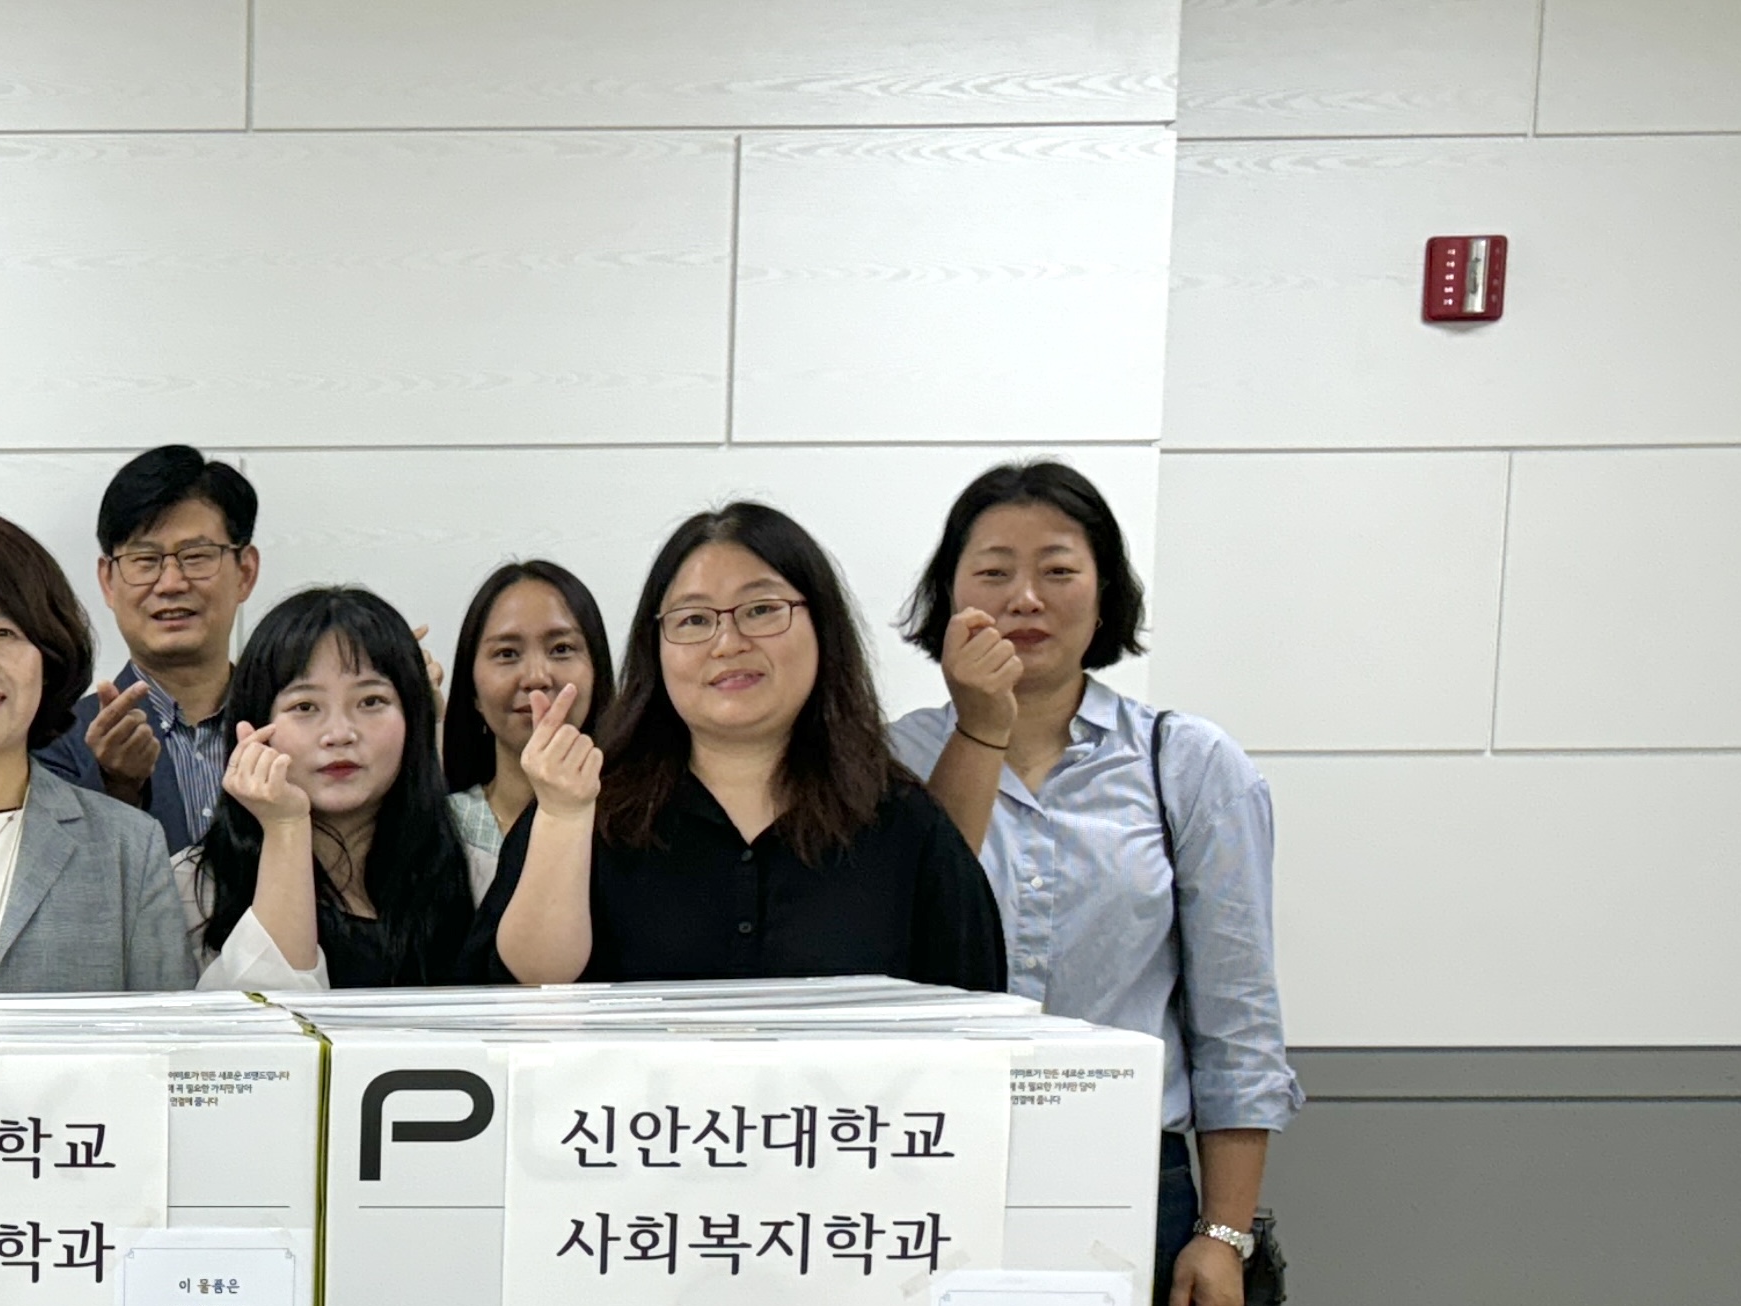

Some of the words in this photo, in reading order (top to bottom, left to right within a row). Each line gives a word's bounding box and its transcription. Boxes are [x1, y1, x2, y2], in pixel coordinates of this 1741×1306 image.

[561, 1105, 955, 1169] 신안산대학교
[556, 1212, 951, 1276] 사회복지학과
[179, 1278, 190, 1293] 이
[197, 1278, 240, 1294] 물품은
